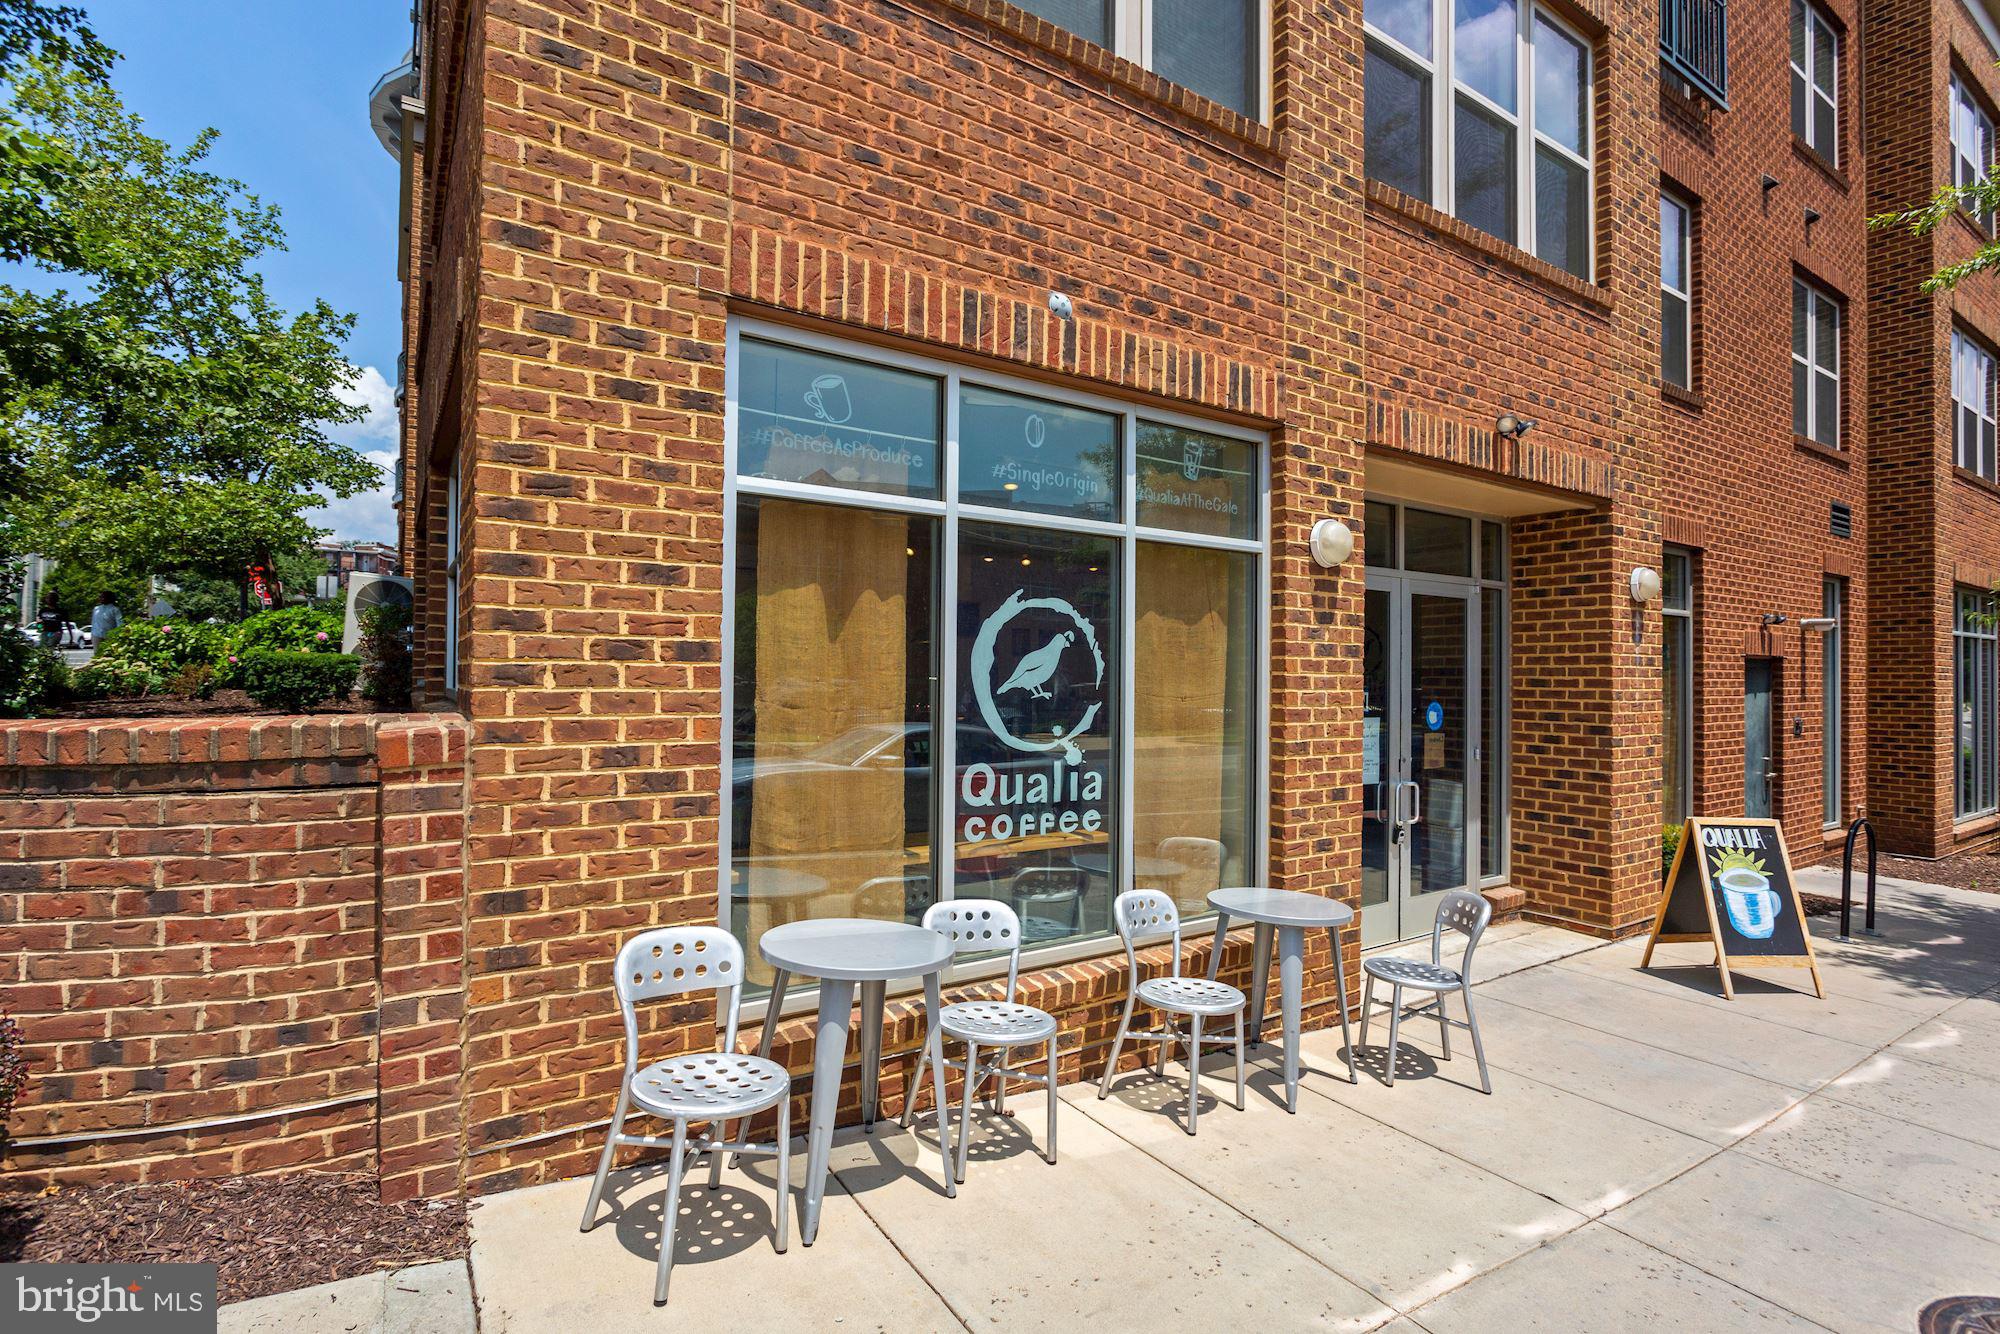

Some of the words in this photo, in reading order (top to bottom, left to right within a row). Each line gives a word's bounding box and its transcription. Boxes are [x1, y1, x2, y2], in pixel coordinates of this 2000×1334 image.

[991, 462, 1098, 496] #SingleOrigin
[962, 760, 1102, 807] Qualia
[1702, 828, 1767, 849] QUALIA
